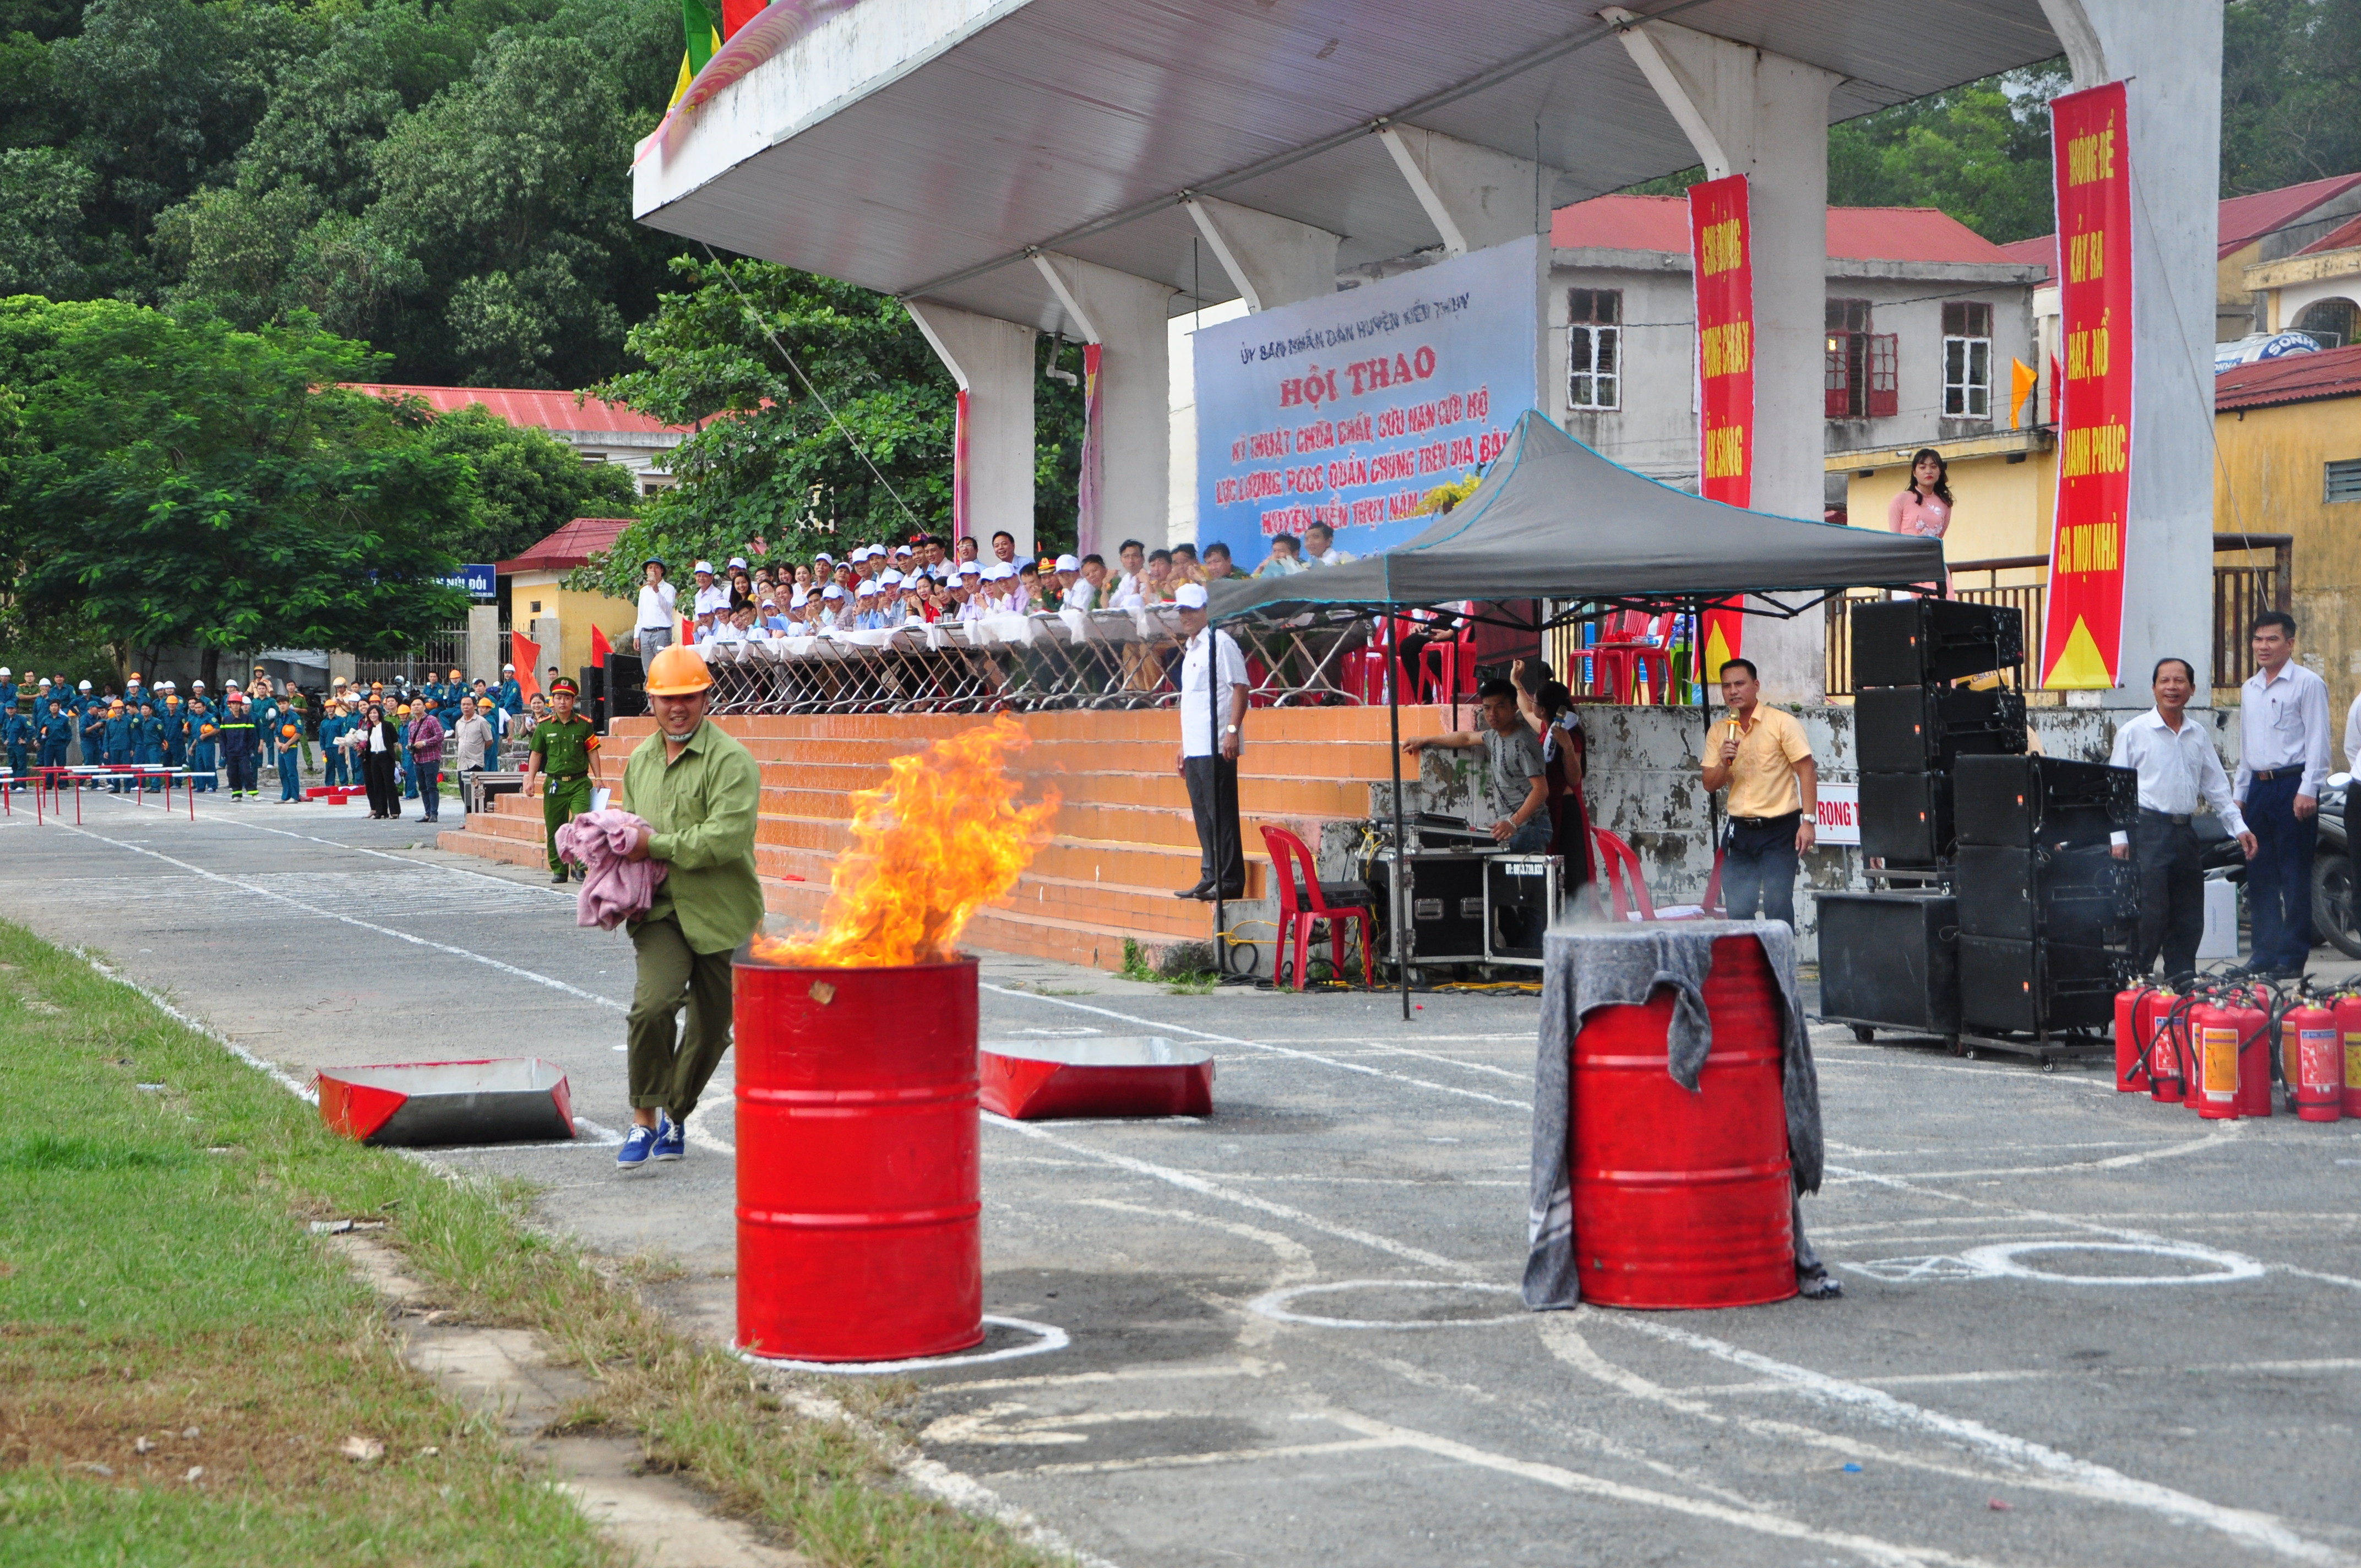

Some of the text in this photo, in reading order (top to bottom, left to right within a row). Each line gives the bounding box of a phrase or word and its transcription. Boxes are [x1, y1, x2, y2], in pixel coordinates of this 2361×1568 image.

[2090, 230, 2103, 280] RA
[1260, 340, 1287, 361] BAN
[2268, 335, 2321, 356] SONH
[1279, 344, 1437, 410] HỘI THAO
[2215, 361, 2237, 372] ONHA
[1467, 385, 1488, 423] HỘ
[2092, 414, 2126, 474] PHÚC
[1285, 464, 1324, 494] PCCC
[2073, 524, 2092, 583] MỌI
[2093, 512, 2117, 572] NHÀ
[469, 574, 487, 590] ĐỐI
[1817, 801, 1852, 831] RỌNG
